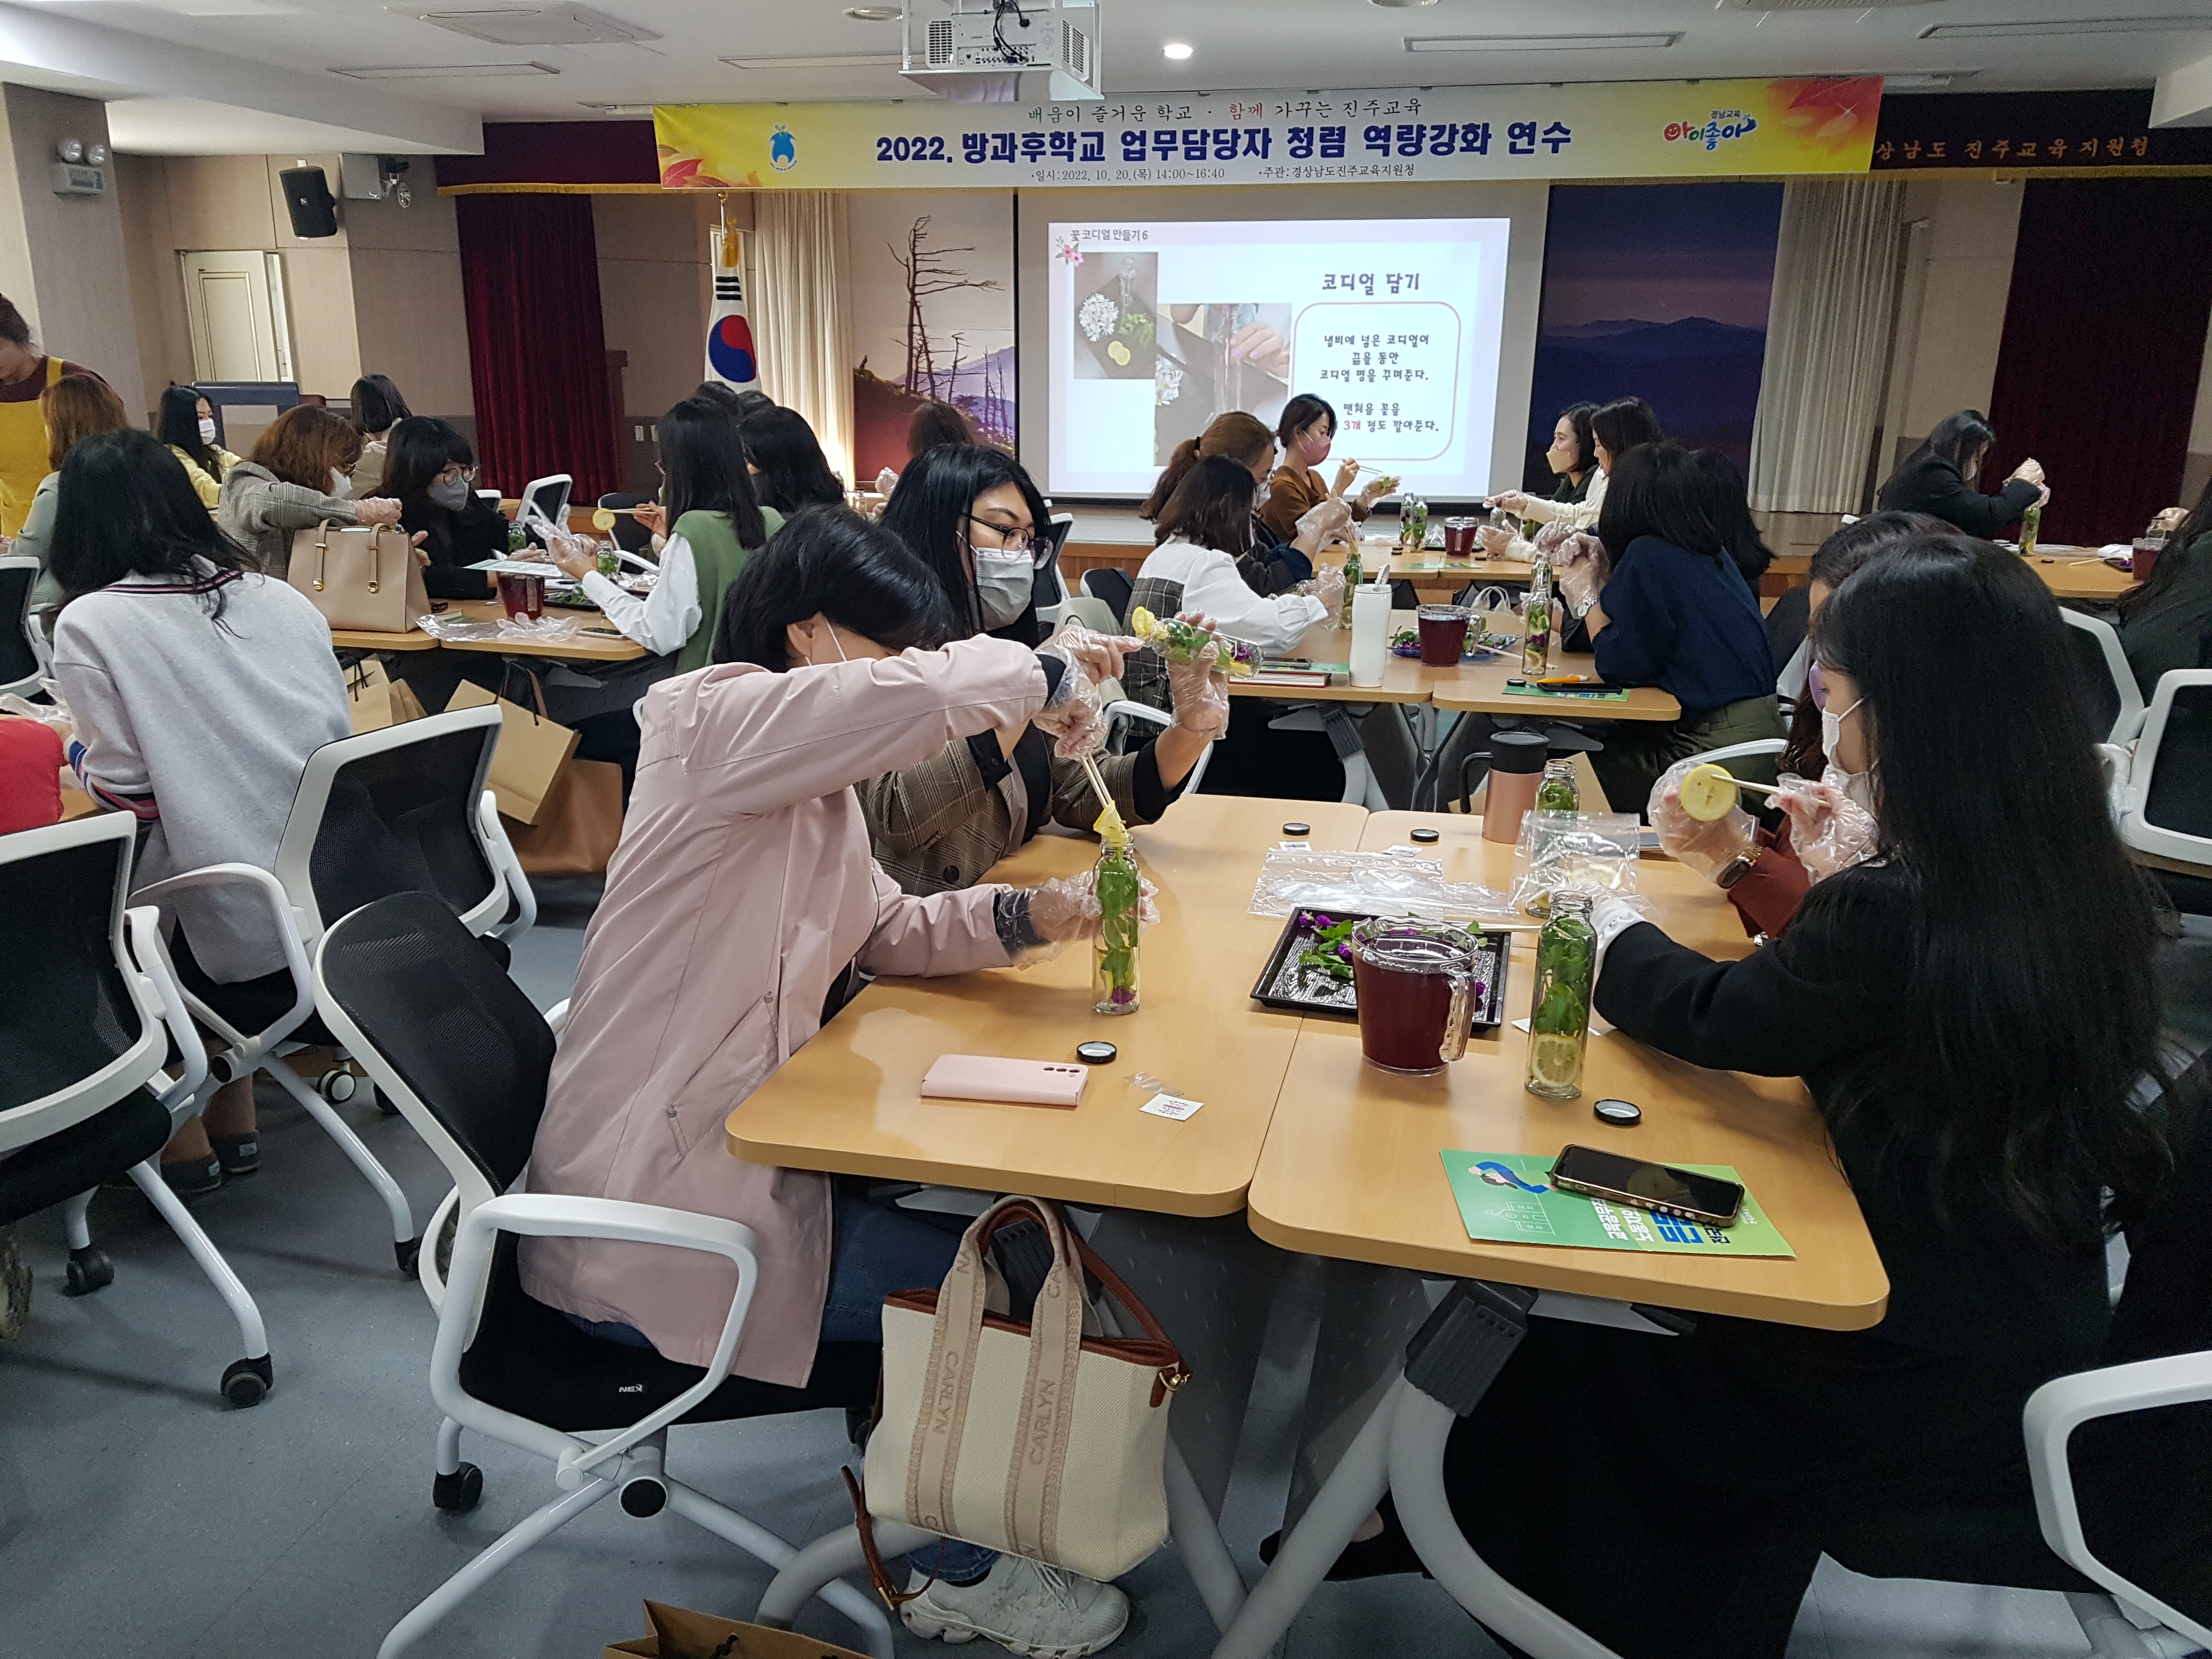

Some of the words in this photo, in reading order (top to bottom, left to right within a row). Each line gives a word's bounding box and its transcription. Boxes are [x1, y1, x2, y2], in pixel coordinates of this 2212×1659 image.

[1028, 106, 1080, 123] 배움이
[1091, 105, 1147, 123] 즐거운
[1156, 104, 1192, 122] 학교
[1228, 102, 1263, 121] 함께
[1275, 101, 1333, 119] 가꾸는
[1343, 98, 1422, 117] 진주교육
[1710, 110, 1741, 120] 경남교육
[1663, 117, 1757, 151] 아이좋아
[876, 136, 953, 163] 2022.
[962, 131, 1105, 163] 방과후학교
[1120, 128, 1272, 161] 업무담당자
[1286, 125, 1346, 159] 청렴
[1363, 122, 1492, 157] 역량강화
[1507, 121, 1572, 155] 연수
[1156, 168, 1224, 179] 14:00~16:40
[1070, 229, 1080, 241] 꽃
[1082, 229, 1110, 240] 코디얼
[1322, 273, 1374, 296] 코디얼
[1386, 273, 1419, 294] 담기
[1324, 335, 1355, 348] 냄비에
[1387, 334, 1429, 348] 코디얼이
[1378, 352, 1399, 365] 동안
[1319, 369, 1350, 382] 코디얼
[1356, 369, 1376, 383] 병을
[1382, 369, 1429, 382] 꾸며준다.
[1343, 403, 1374, 416] 맨처음
[1380, 402, 1400, 416] 꽃을
[1343, 420, 1362, 431] 3개
[1367, 420, 1386, 432] 정도
[1392, 420, 1439, 433] 깔아준다.
[932, 1351, 959, 1434] CARLYN
[1030, 1379, 1056, 1464] CARLYN
